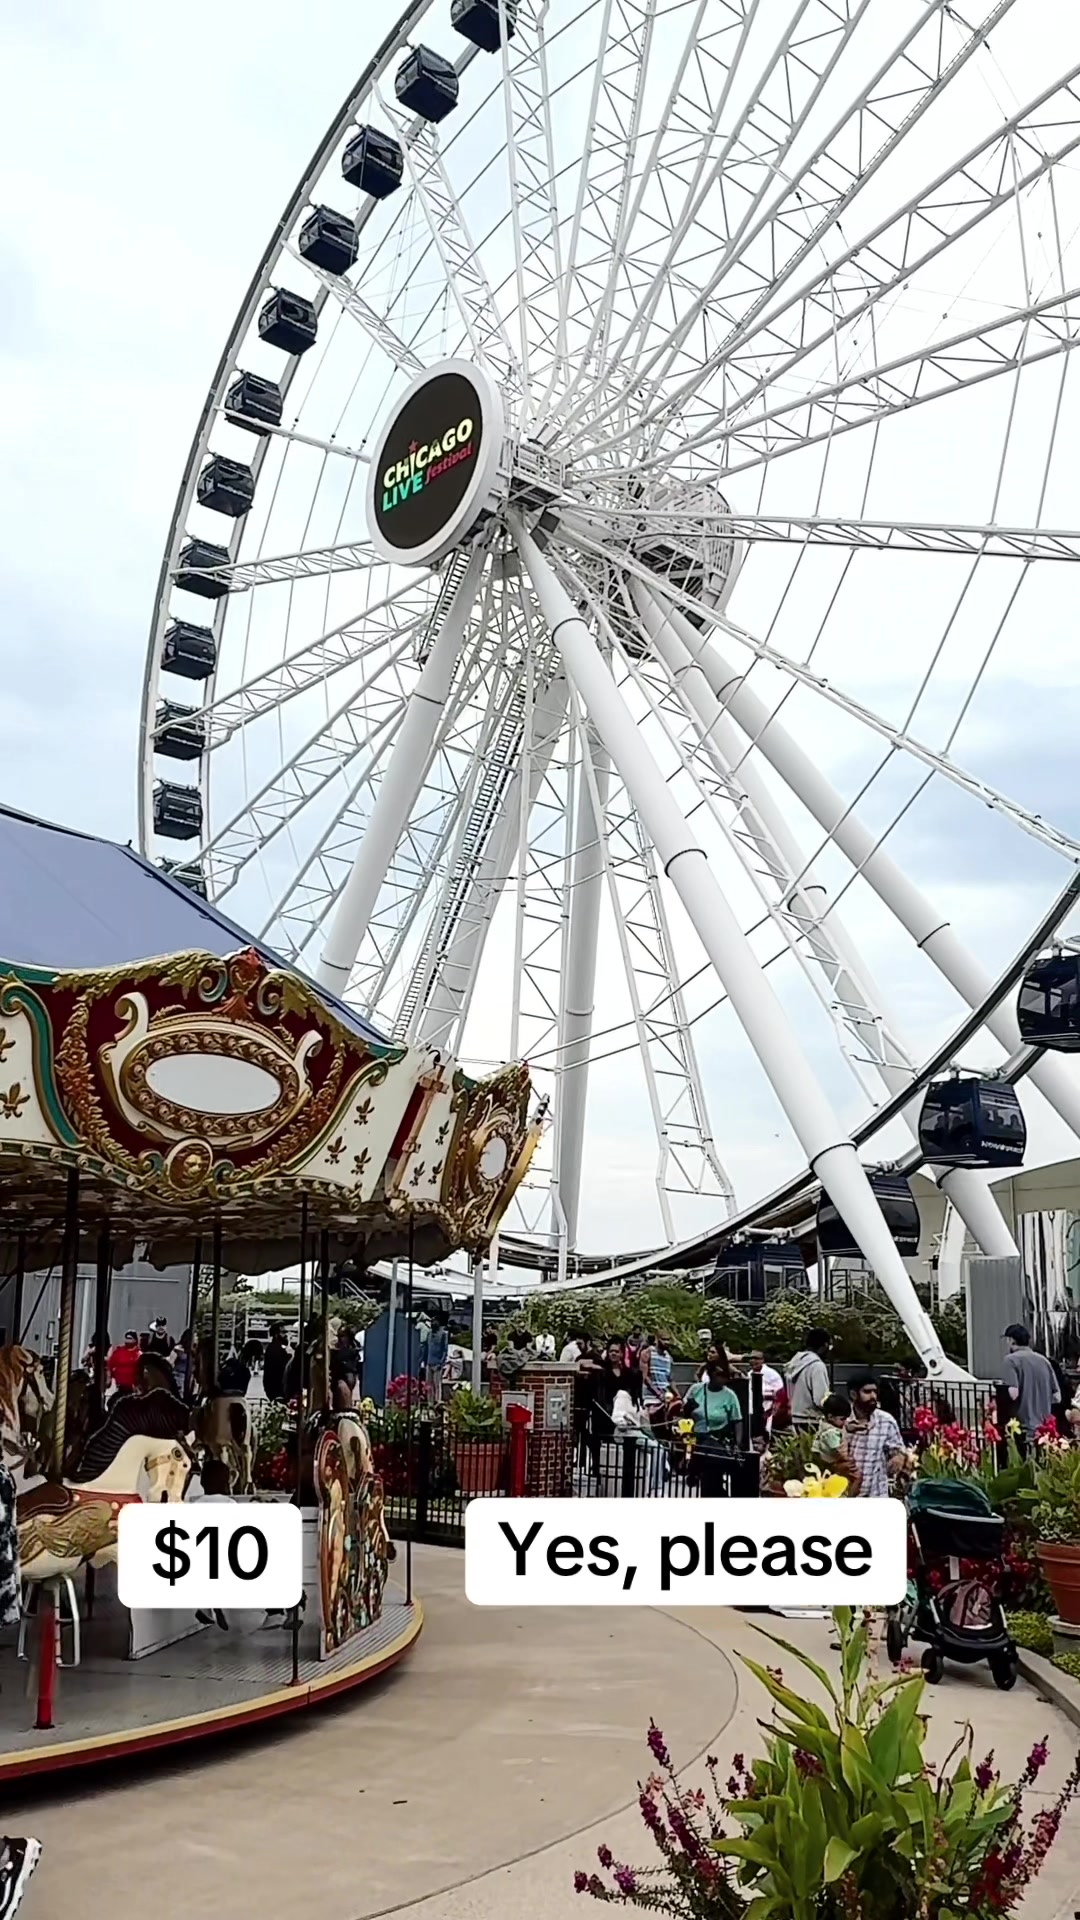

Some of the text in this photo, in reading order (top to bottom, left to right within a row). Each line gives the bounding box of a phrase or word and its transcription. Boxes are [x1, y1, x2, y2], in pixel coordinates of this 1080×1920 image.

[382, 441, 474, 512] LIVE festival
[383, 418, 474, 488] CHICAGO
